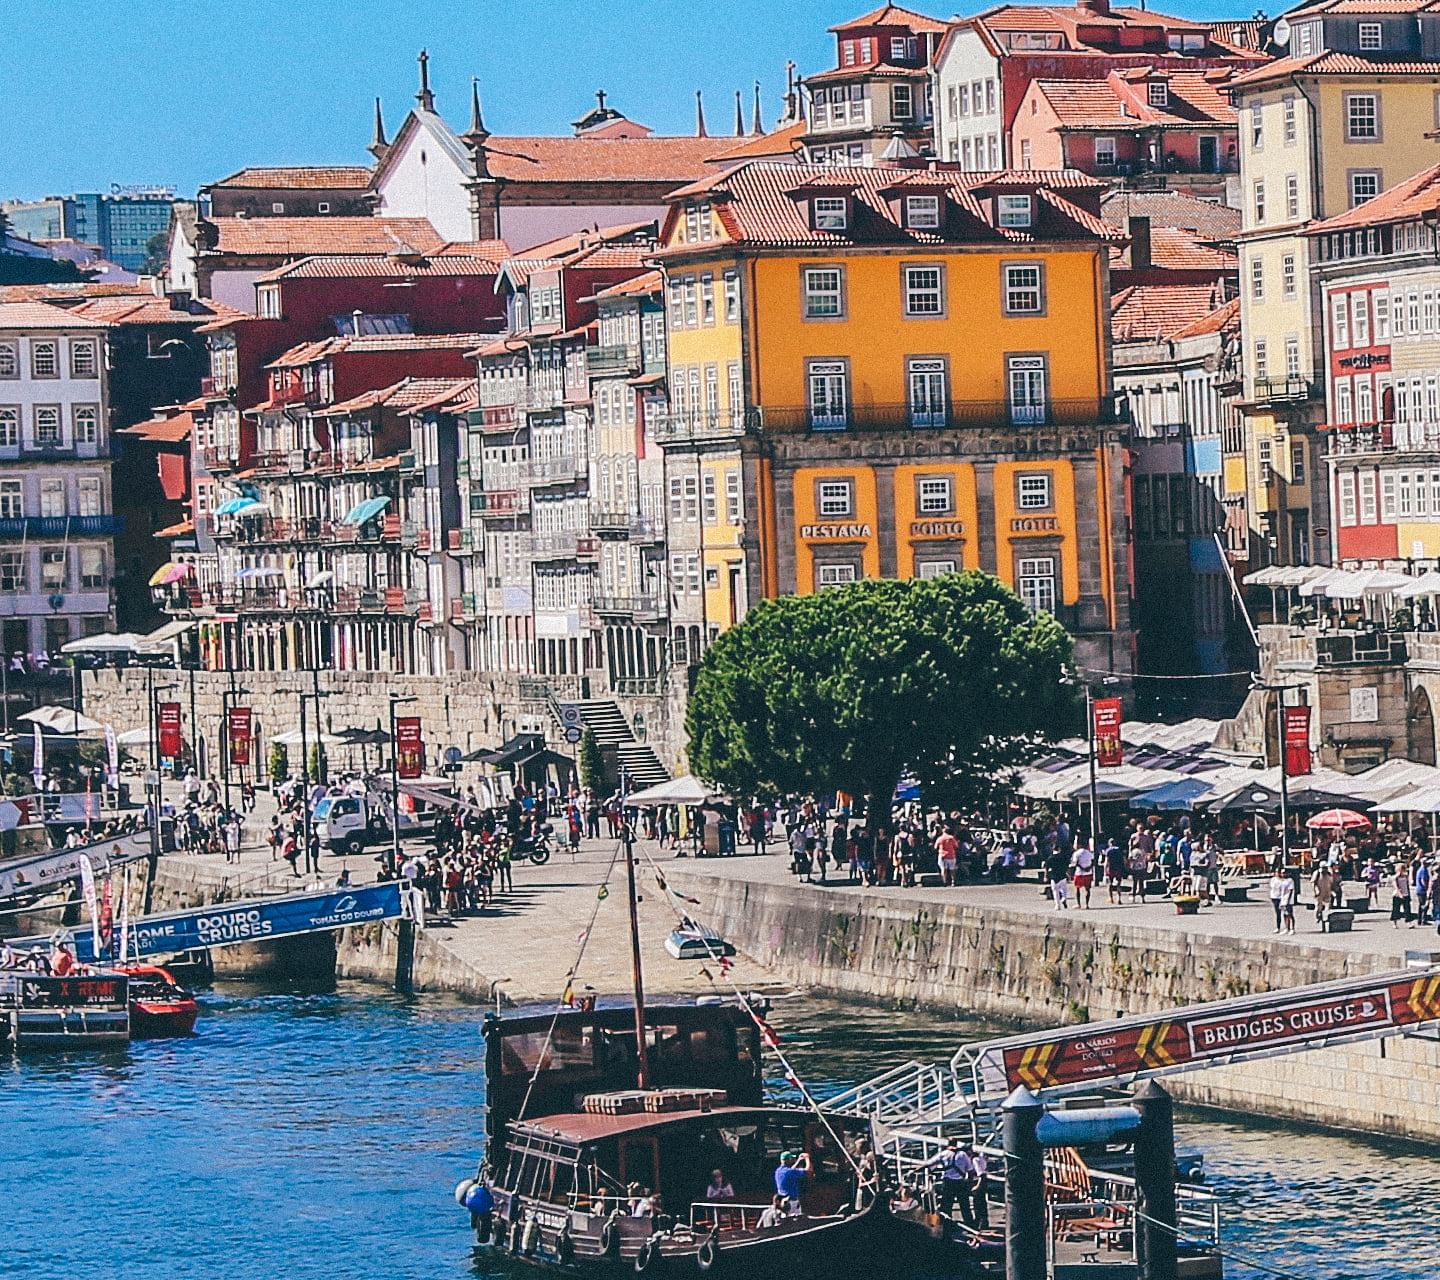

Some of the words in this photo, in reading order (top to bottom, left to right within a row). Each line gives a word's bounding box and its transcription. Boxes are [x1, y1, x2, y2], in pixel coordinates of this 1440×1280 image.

[801, 524, 872, 538] PESTANA
[911, 522, 966, 536] PORTO
[1011, 518, 1060, 532] HOTEL
[197, 910, 260, 931] DOURO
[198, 920, 272, 944] CRUISES
[1203, 1017, 1284, 1045] BRIDGES
[1290, 1004, 1357, 1029] CRUISE
